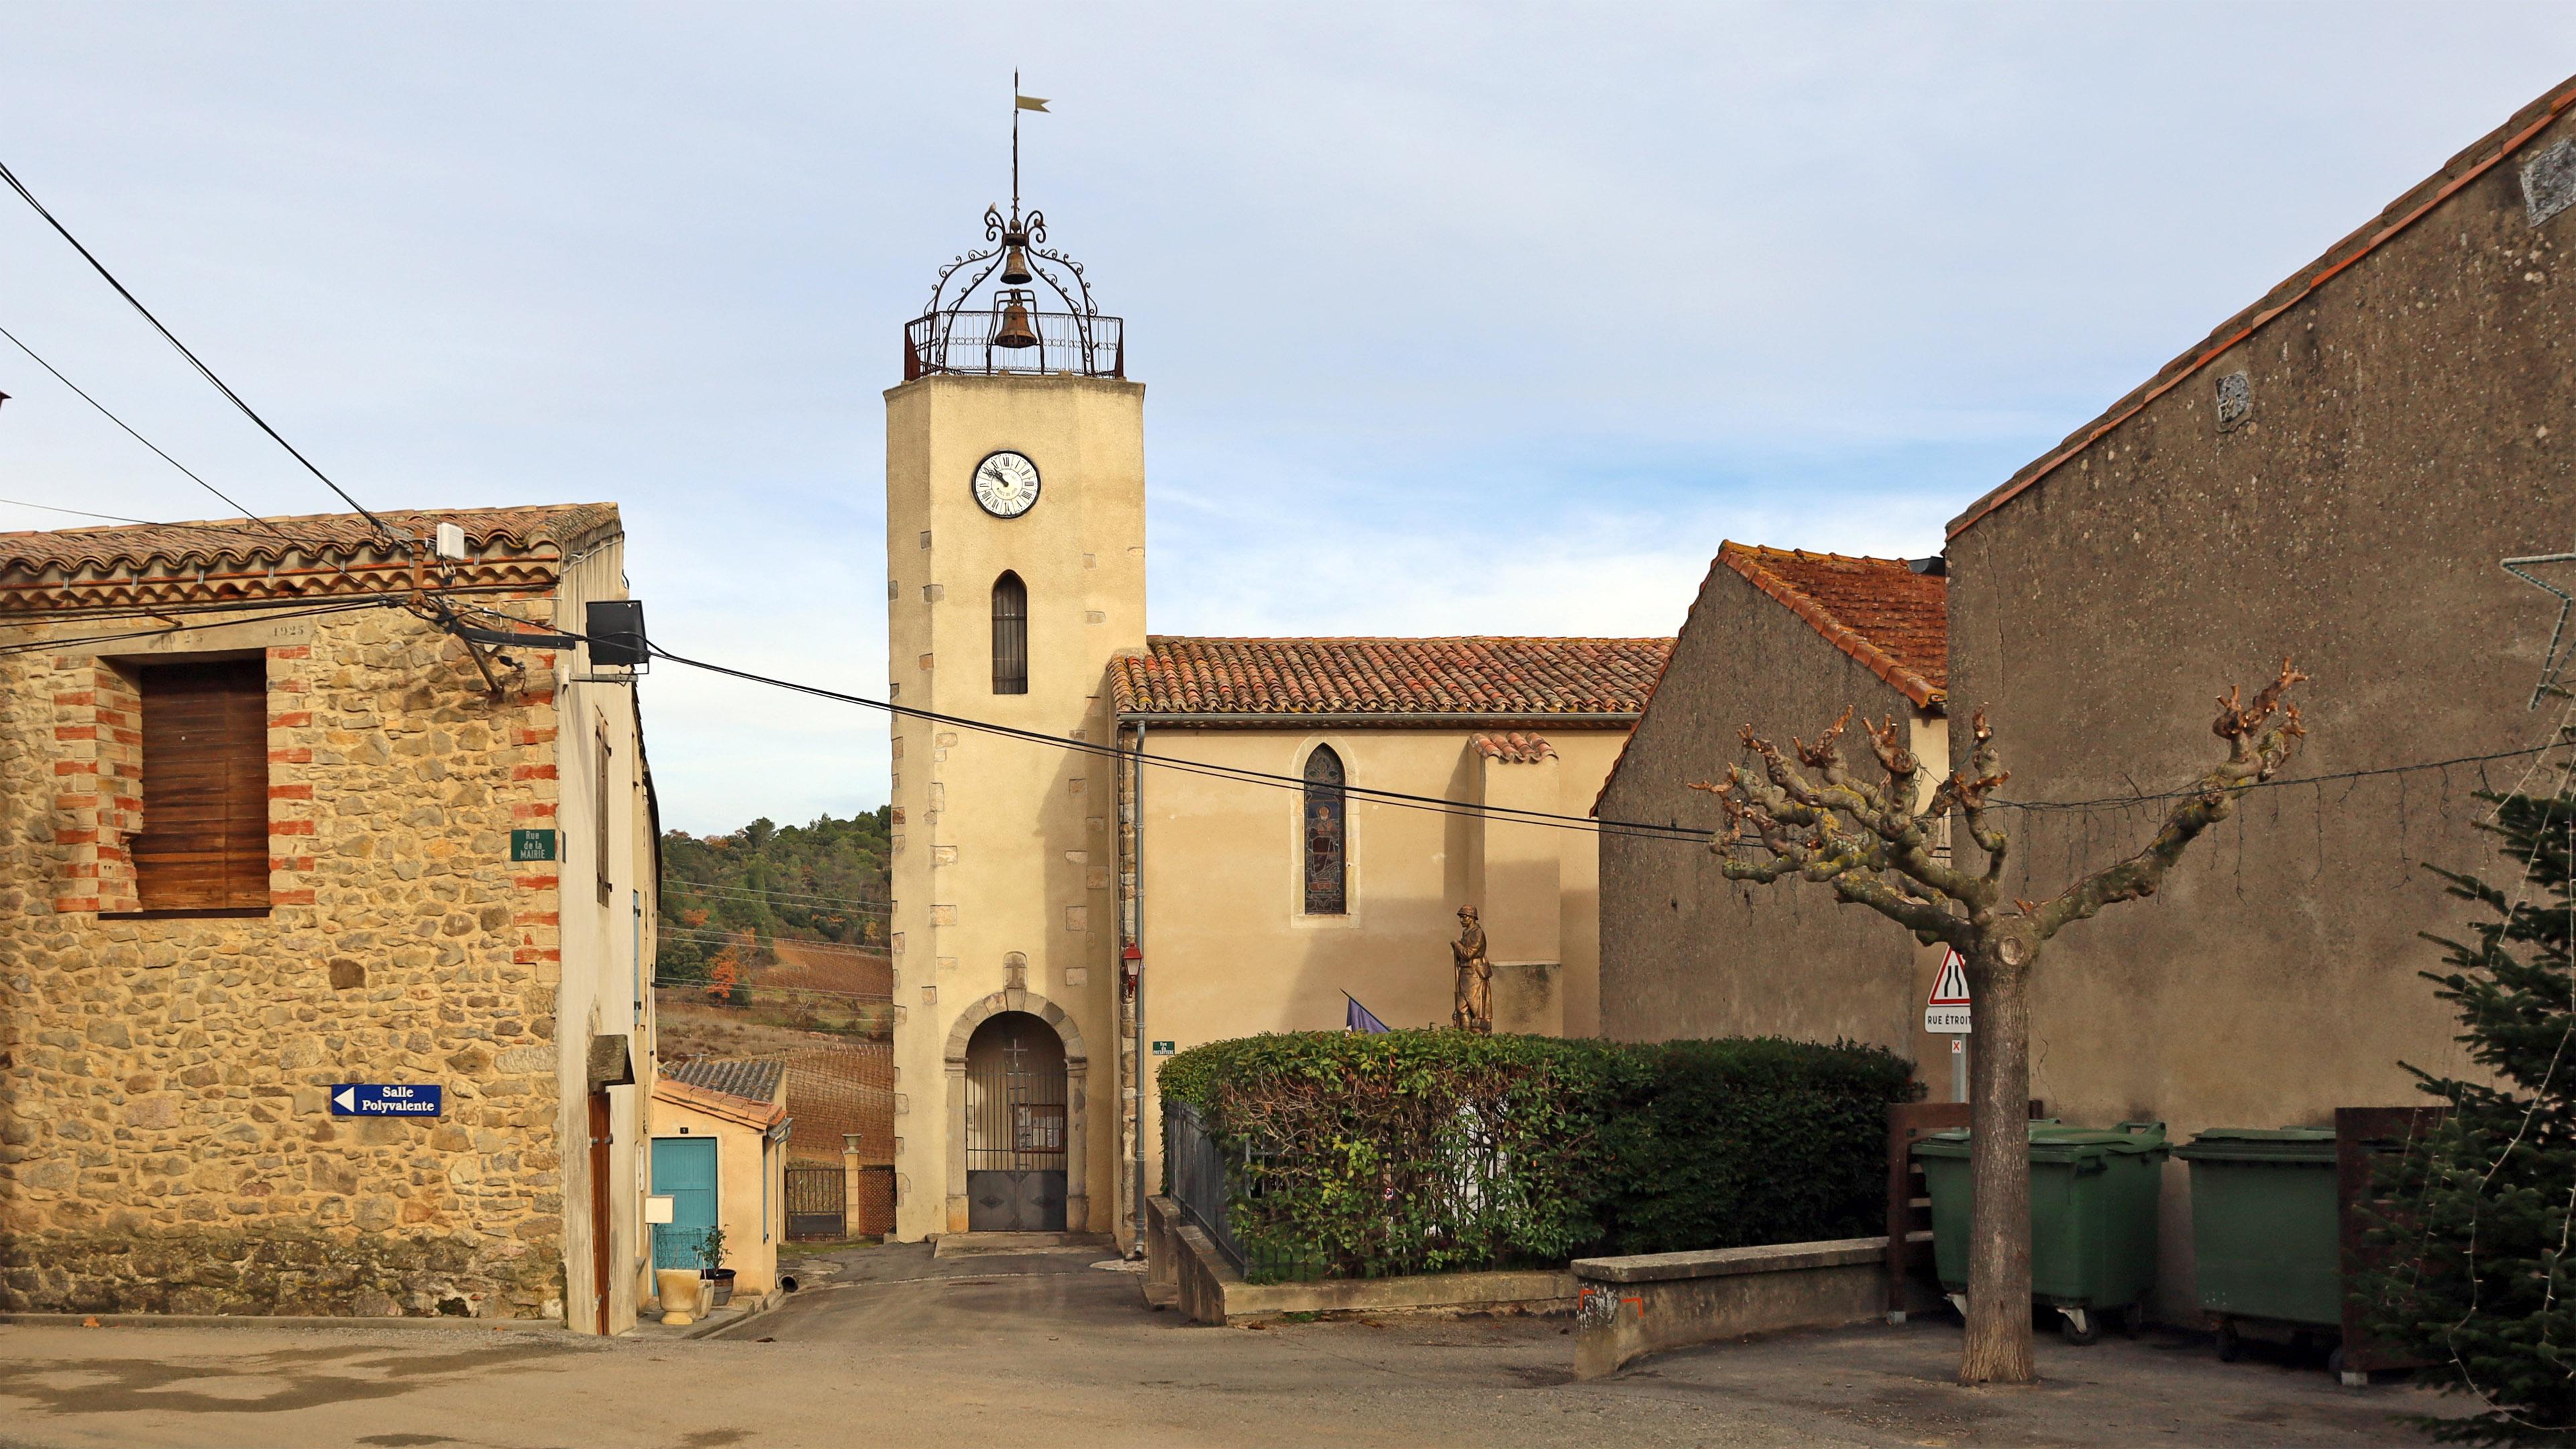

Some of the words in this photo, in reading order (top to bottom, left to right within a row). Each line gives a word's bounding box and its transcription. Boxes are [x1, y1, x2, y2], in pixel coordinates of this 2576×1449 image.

[274, 625, 303, 637] 1925
[525, 831, 539, 839] Rue
[524, 841, 533, 849] de
[535, 841, 542, 849] la
[520, 849, 545, 859] MAIRIE
[1927, 1016, 1942, 1024] RUE
[382, 1086, 414, 1097] Salle
[362, 1099, 435, 1114] Polyvalente
